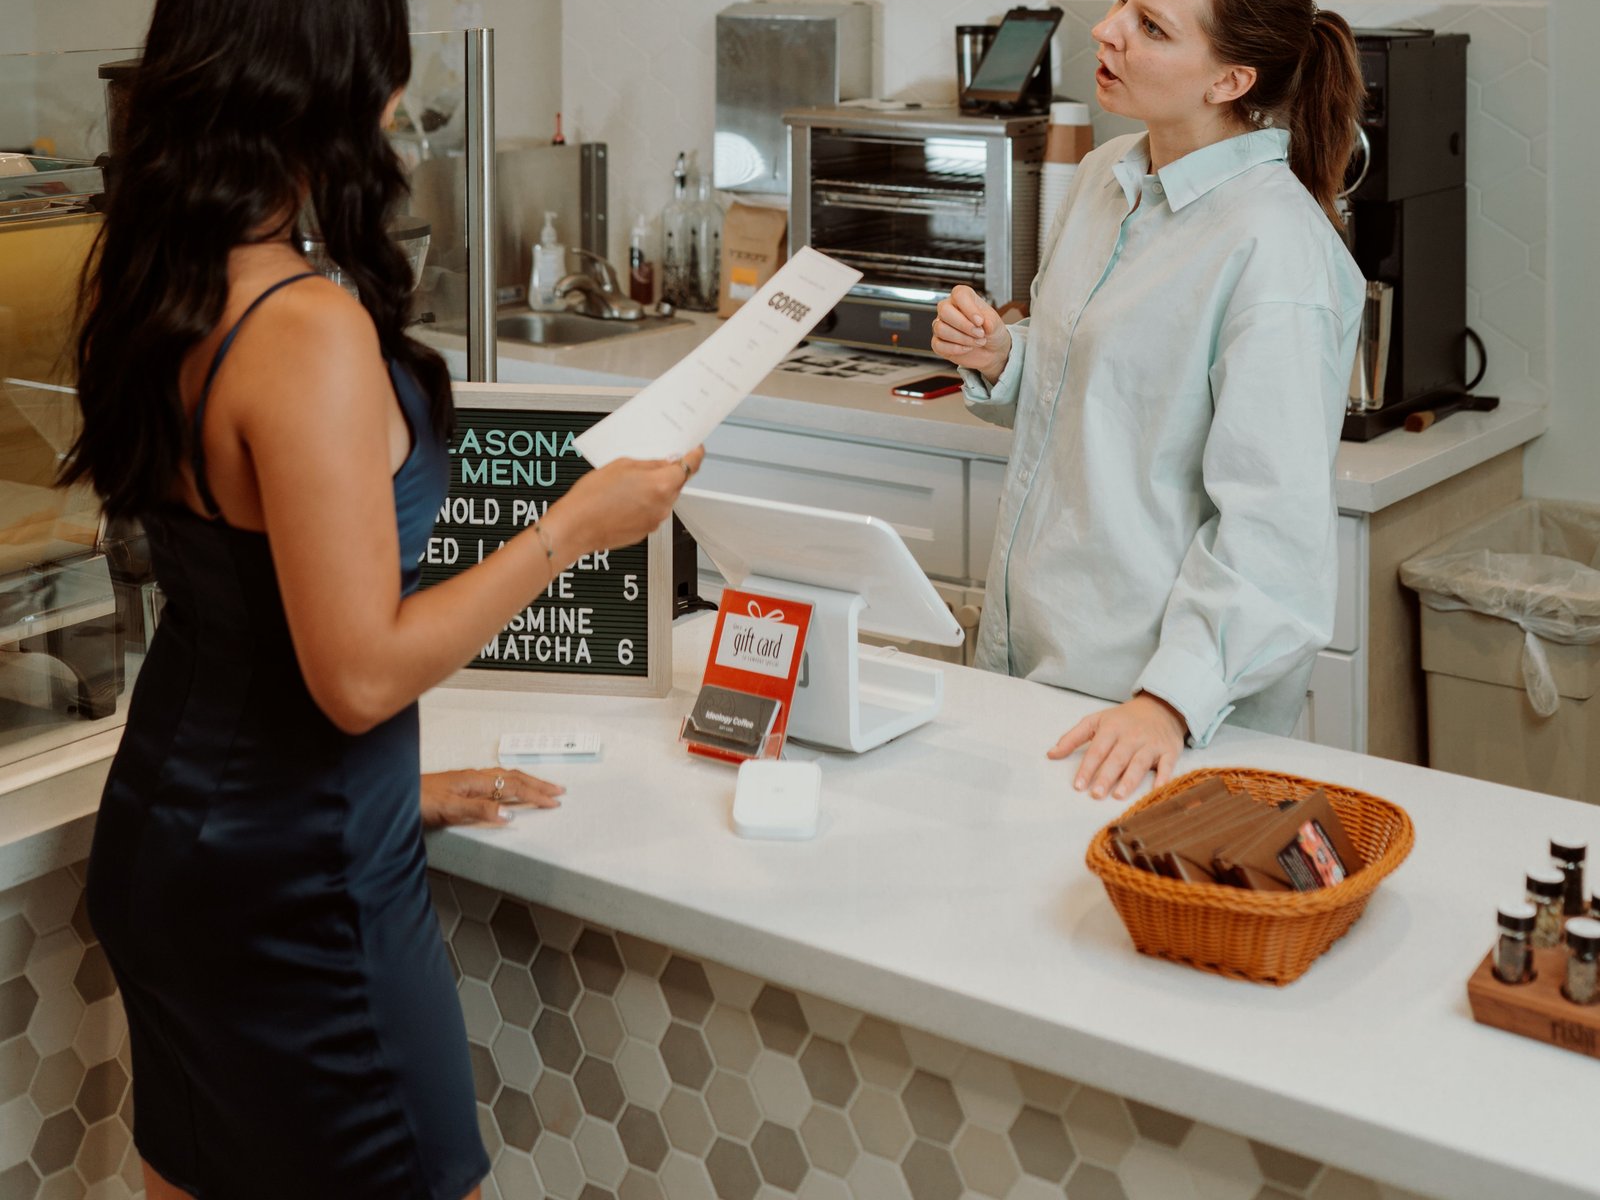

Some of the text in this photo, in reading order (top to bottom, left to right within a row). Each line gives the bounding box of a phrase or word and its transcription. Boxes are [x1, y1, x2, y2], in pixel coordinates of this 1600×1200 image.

[768, 291, 811, 322] COFFEE
[448, 428, 584, 457] ASONA
[462, 458, 557, 487] MENU
[418, 537, 459, 565] ED
[623, 574, 639, 601] 5
[480, 634, 634, 666] MATCHA 6
[733, 626, 784, 660] gift card
[705, 710, 733, 726] Ideology
[732, 715, 755, 730] Coffee
